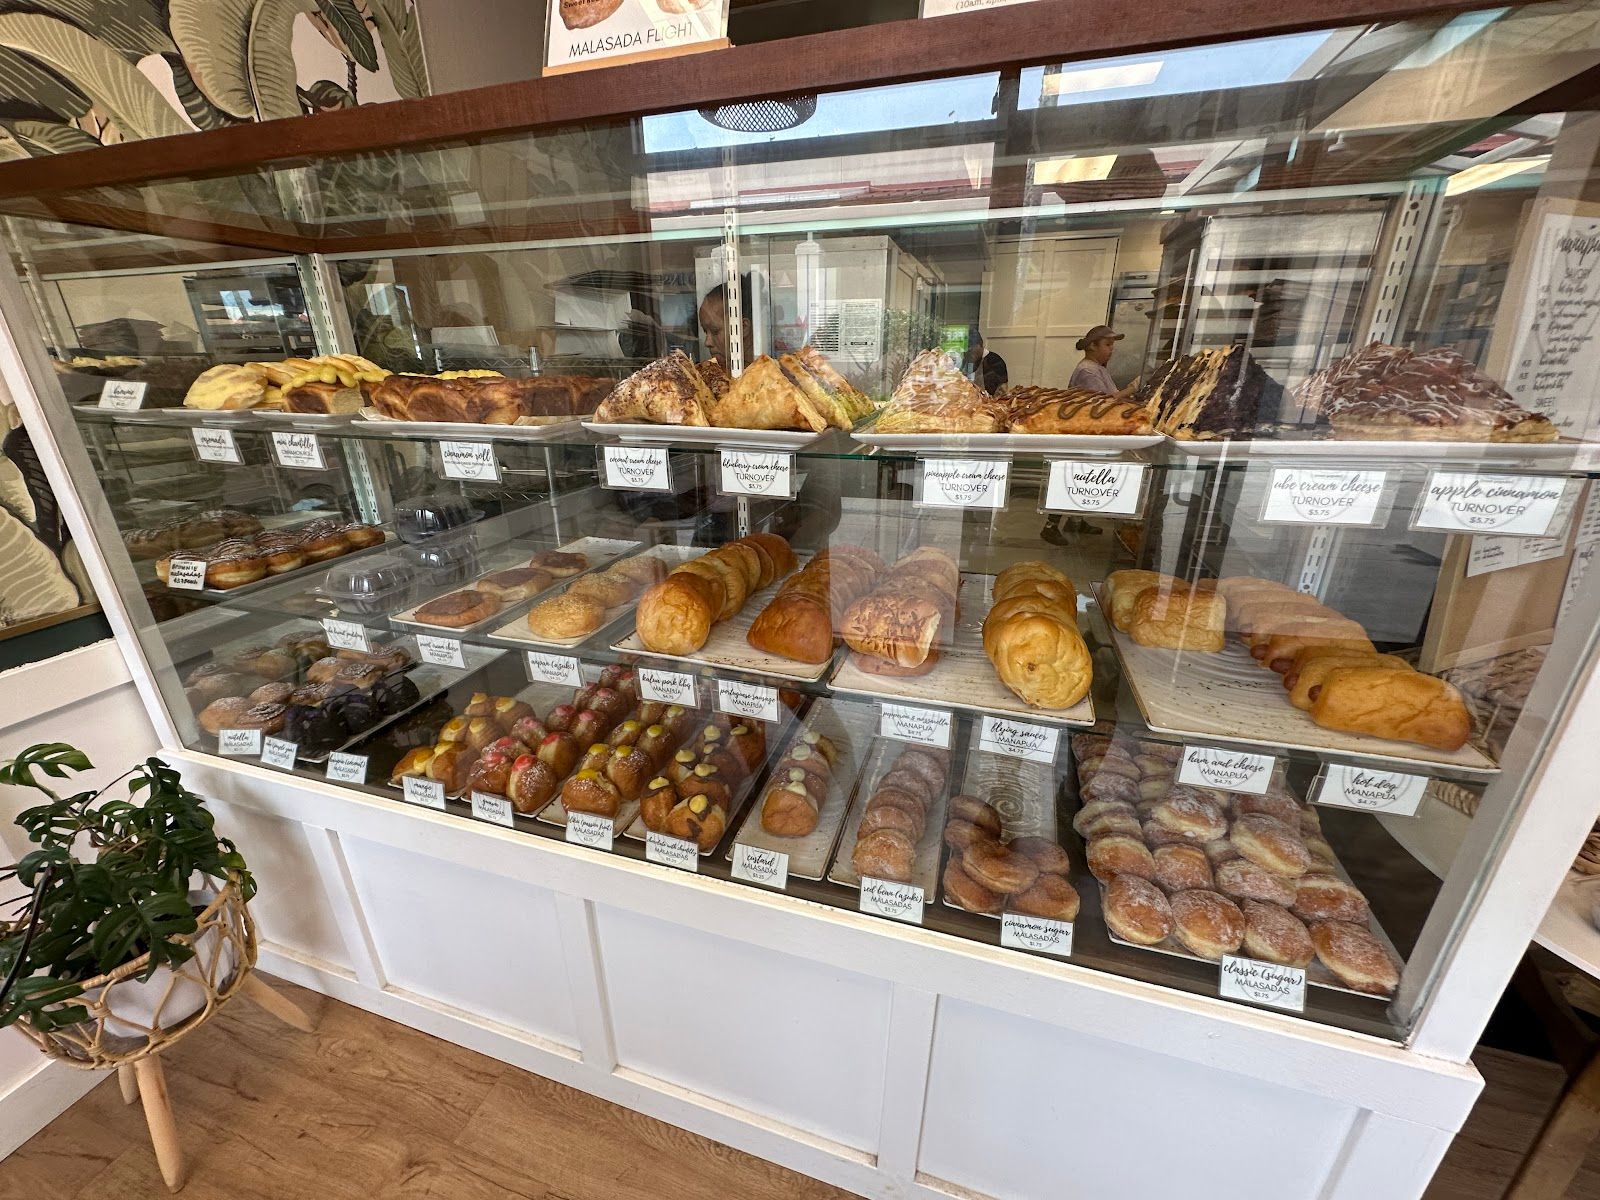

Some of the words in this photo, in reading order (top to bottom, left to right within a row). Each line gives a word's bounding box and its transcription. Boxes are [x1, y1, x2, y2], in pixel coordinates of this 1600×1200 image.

[568, 32, 642, 58] MALASADA
[647, 22, 692, 44] FLIGHT
[444, 450, 474, 460] cinnamon
[475, 448, 491, 462] roll
[646, 455, 662, 466] cheese
[722, 458, 751, 472] blueberry
[770, 460, 788, 472] cheese
[619, 468, 654, 476] TURNOVER
[736, 472, 775, 482] TURNOVER
[924, 470, 960, 481] pineapple
[962, 472, 982, 480] cream
[983, 468, 1006, 482] cheese
[1074, 468, 1118, 485] nutella
[941, 482, 988, 493] TURNOVER
[1274, 472, 1296, 490] ube
[1300, 480, 1337, 491] cream
[1341, 474, 1380, 494] cheese
[1067, 486, 1119, 498] TURNOVER
[1430, 480, 1482, 502] apple
[1486, 487, 1560, 500] cinnamon
[1291, 496, 1354, 507] TURNOVER
[1451, 502, 1526, 515] TURNOVER
[552, 660, 574, 670] (azuki)
[542, 670, 568, 678] MANAPUA
[642, 674, 660, 684] kalua
[661, 678, 676, 687] pork
[679, 678, 692, 690] bbq
[653, 686, 680, 695] MANAPUA
[720, 688, 752, 699] portuguese
[752, 694, 776, 704] sausage
[732, 698, 762, 708] MANAPUA
[896, 721, 933, 732] MANAPUA
[990, 722, 1018, 738] flying
[1020, 730, 1048, 740] saucer
[228, 732, 248, 741] nutella
[998, 737, 1037, 748] MANAPUA
[1188, 750, 1208, 764] ham
[1212, 759, 1232, 768] and
[1234, 758, 1264, 772] cheese
[334, 766, 359, 774] MALASADAS
[1200, 768, 1248, 780] MANAPUA
[414, 783, 432, 792] mango
[1352, 772, 1374, 788] hot
[1374, 780, 1398, 793] dog
[410, 790, 438, 800] MALASADAS
[1344, 788, 1396, 801] MANAPUA
[1358, 798, 1377, 806] $4.75
[478, 806, 506, 816] MALASADAS
[574, 826, 604, 838] MALASADAS
[654, 847, 688, 861] MALASADAS
[746, 854, 775, 866] custard
[742, 863, 778, 876] MALASADAS
[864, 884, 876, 894] red
[877, 885, 894, 896] bean
[895, 890, 922, 904] (azuki)
[870, 896, 912, 910] MALASADAS
[1004, 920, 1042, 930] cinnamon
[1043, 925, 1071, 936] sugar
[1012, 932, 1060, 944] MALASADAS
[1224, 960, 1258, 977] classic
[1260, 968, 1303, 986] (sugar)
[1234, 978, 1290, 995] MALASADAS
